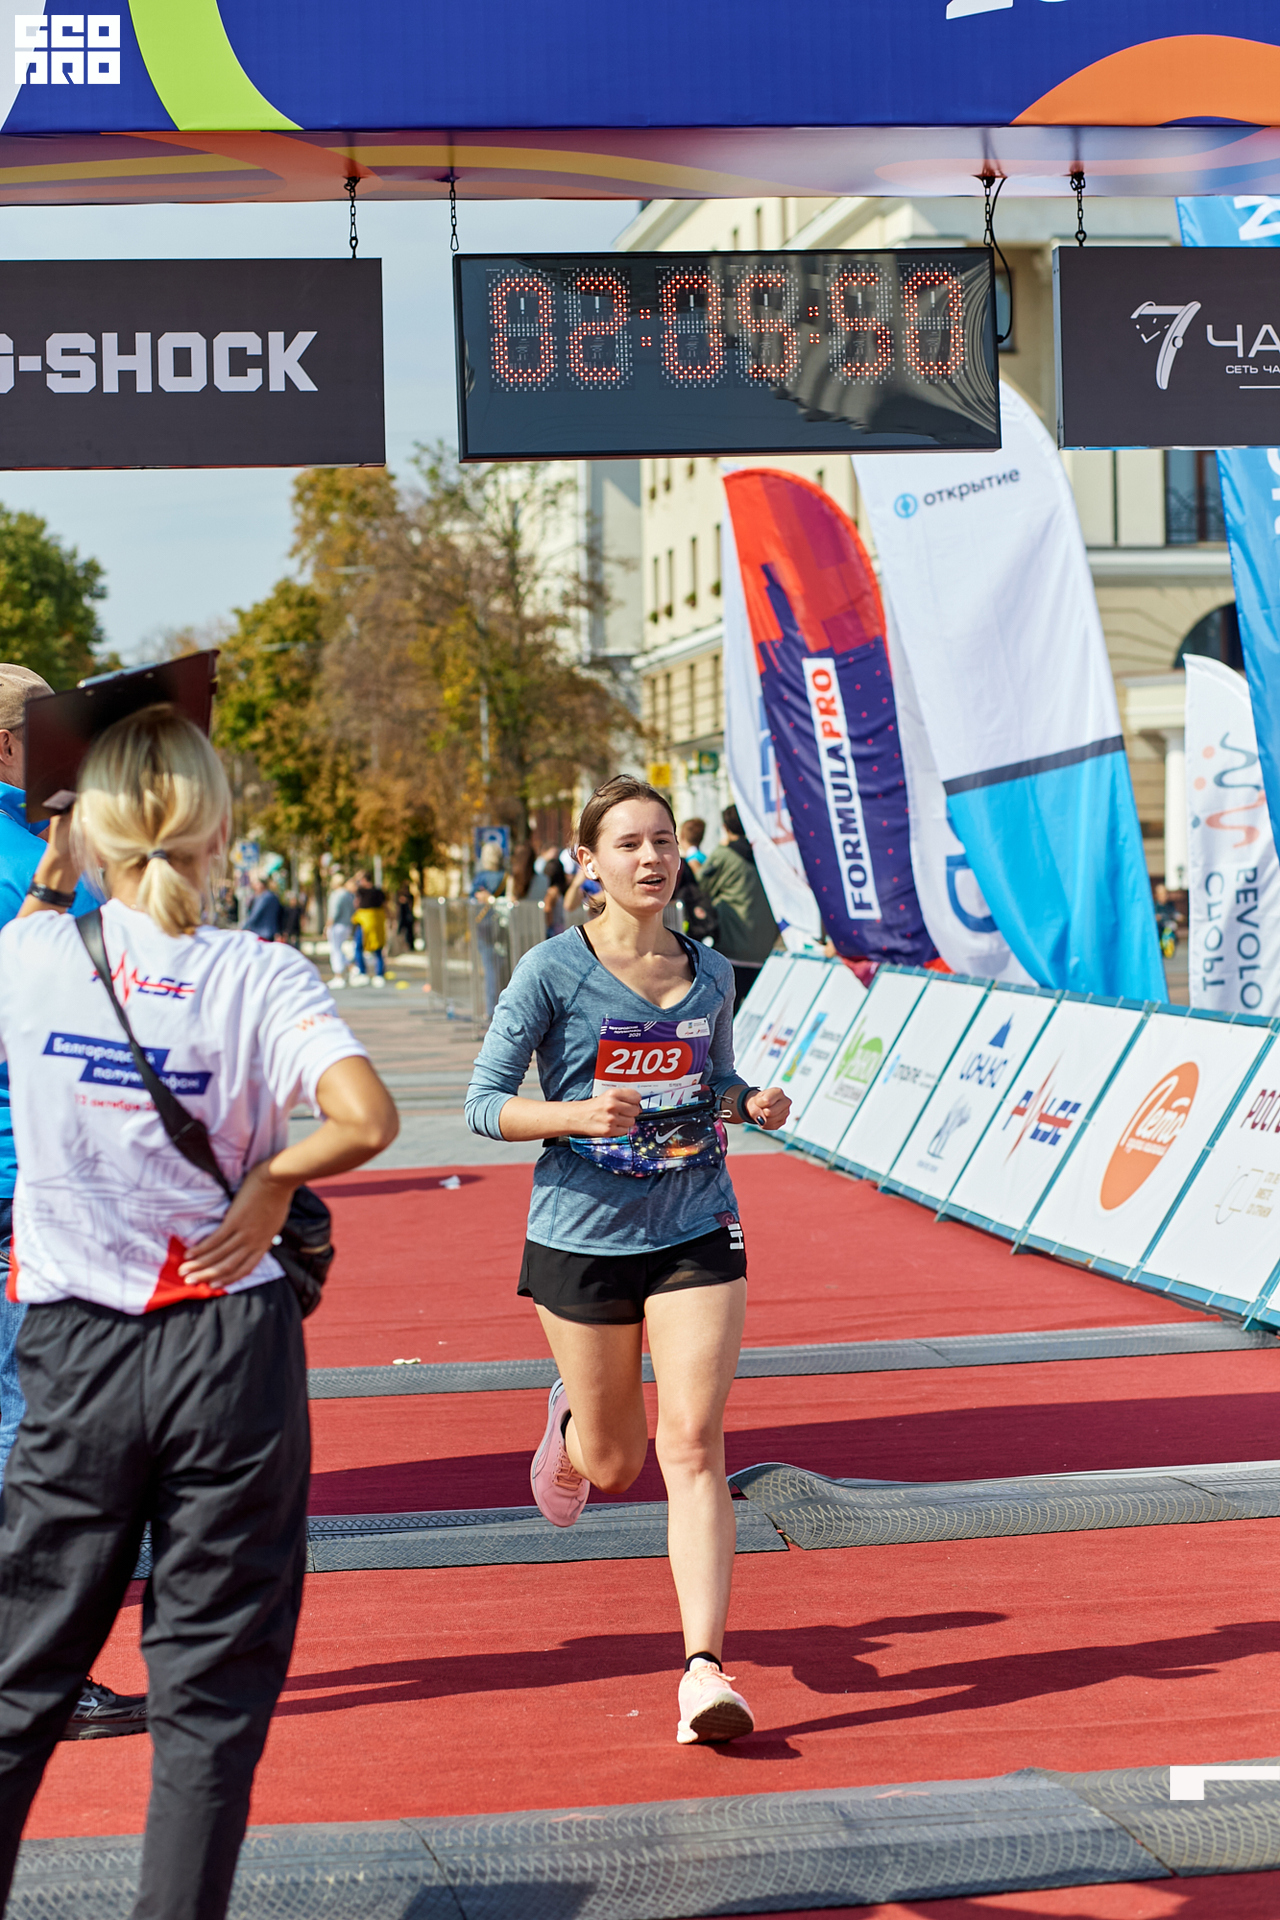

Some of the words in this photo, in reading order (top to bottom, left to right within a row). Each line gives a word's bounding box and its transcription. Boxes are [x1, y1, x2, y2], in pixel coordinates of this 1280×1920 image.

[492, 272, 965, 383] 02:05:50
[0, 331, 318, 394] -SHOCK
[1225, 365, 1258, 374] СЕТЬ
[923, 468, 1020, 506] открытие
[604, 1048, 682, 1075] 2103
